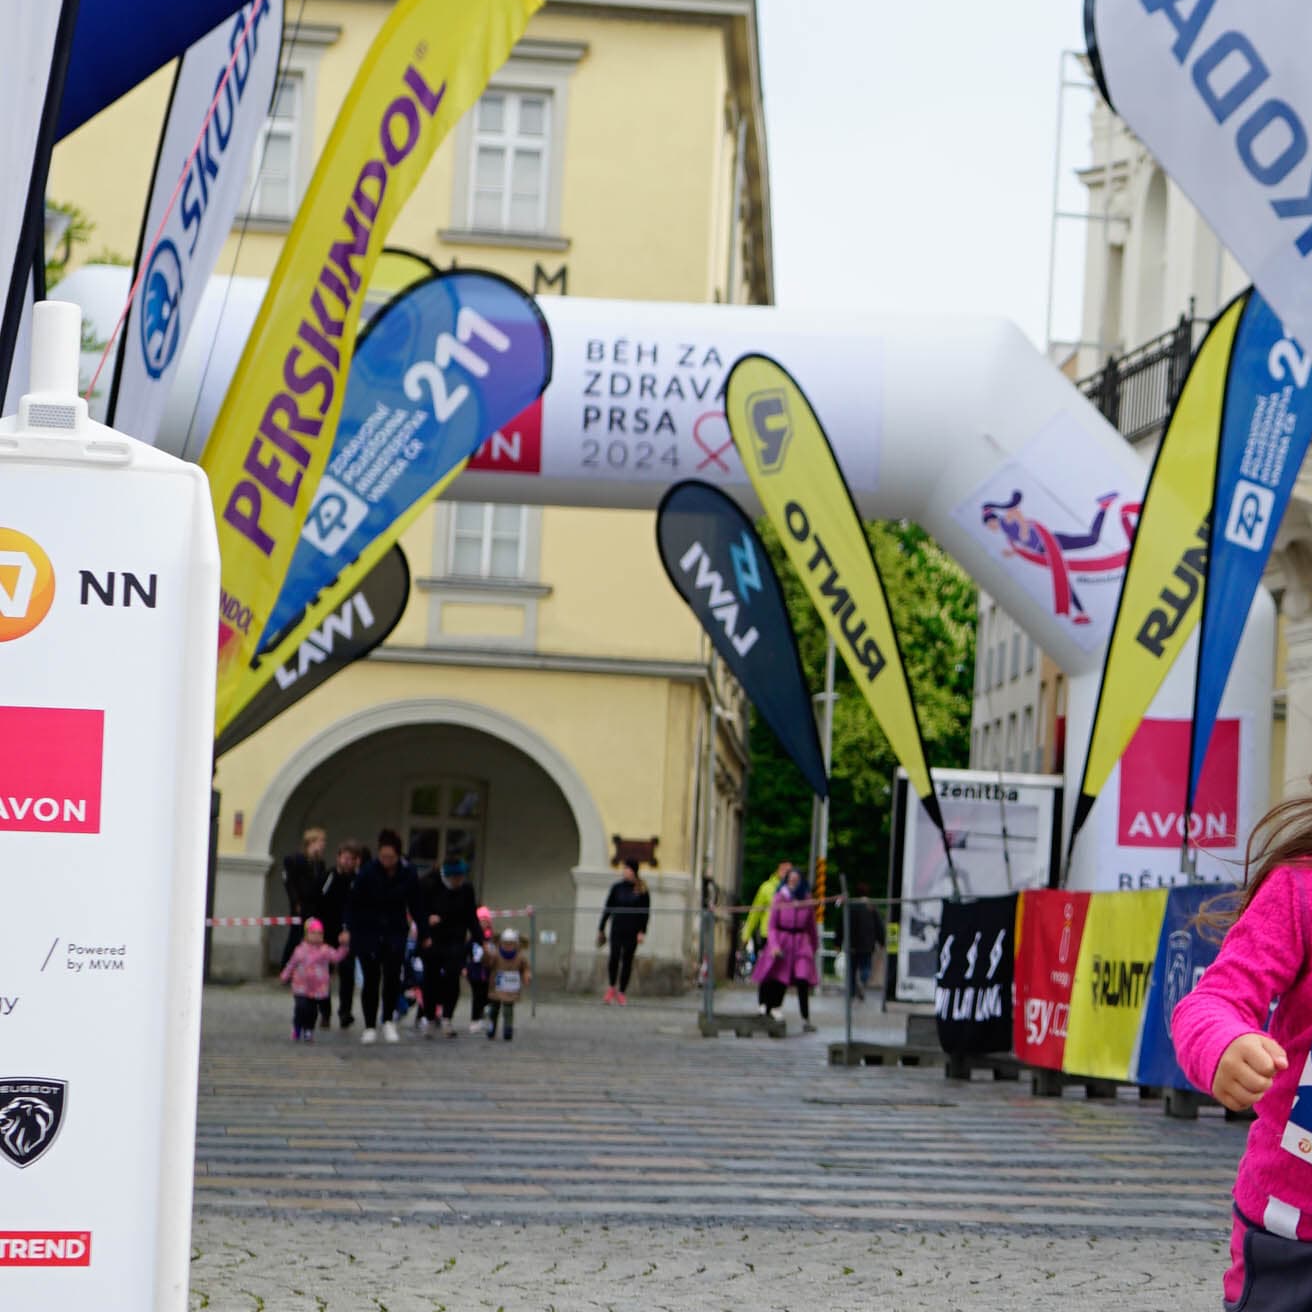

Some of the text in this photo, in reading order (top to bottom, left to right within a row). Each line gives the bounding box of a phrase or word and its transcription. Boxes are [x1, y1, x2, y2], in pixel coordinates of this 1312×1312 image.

[403, 306, 511, 423] 211
[678, 344, 723, 369] ZA
[582, 405, 677, 436] PRSA
[581, 438, 680, 471] 2024
[79, 569, 158, 608] NN
[1128, 811, 1228, 839] AVON
[68, 944, 126, 956] Powered
[67, 959, 125, 972] by MVM
